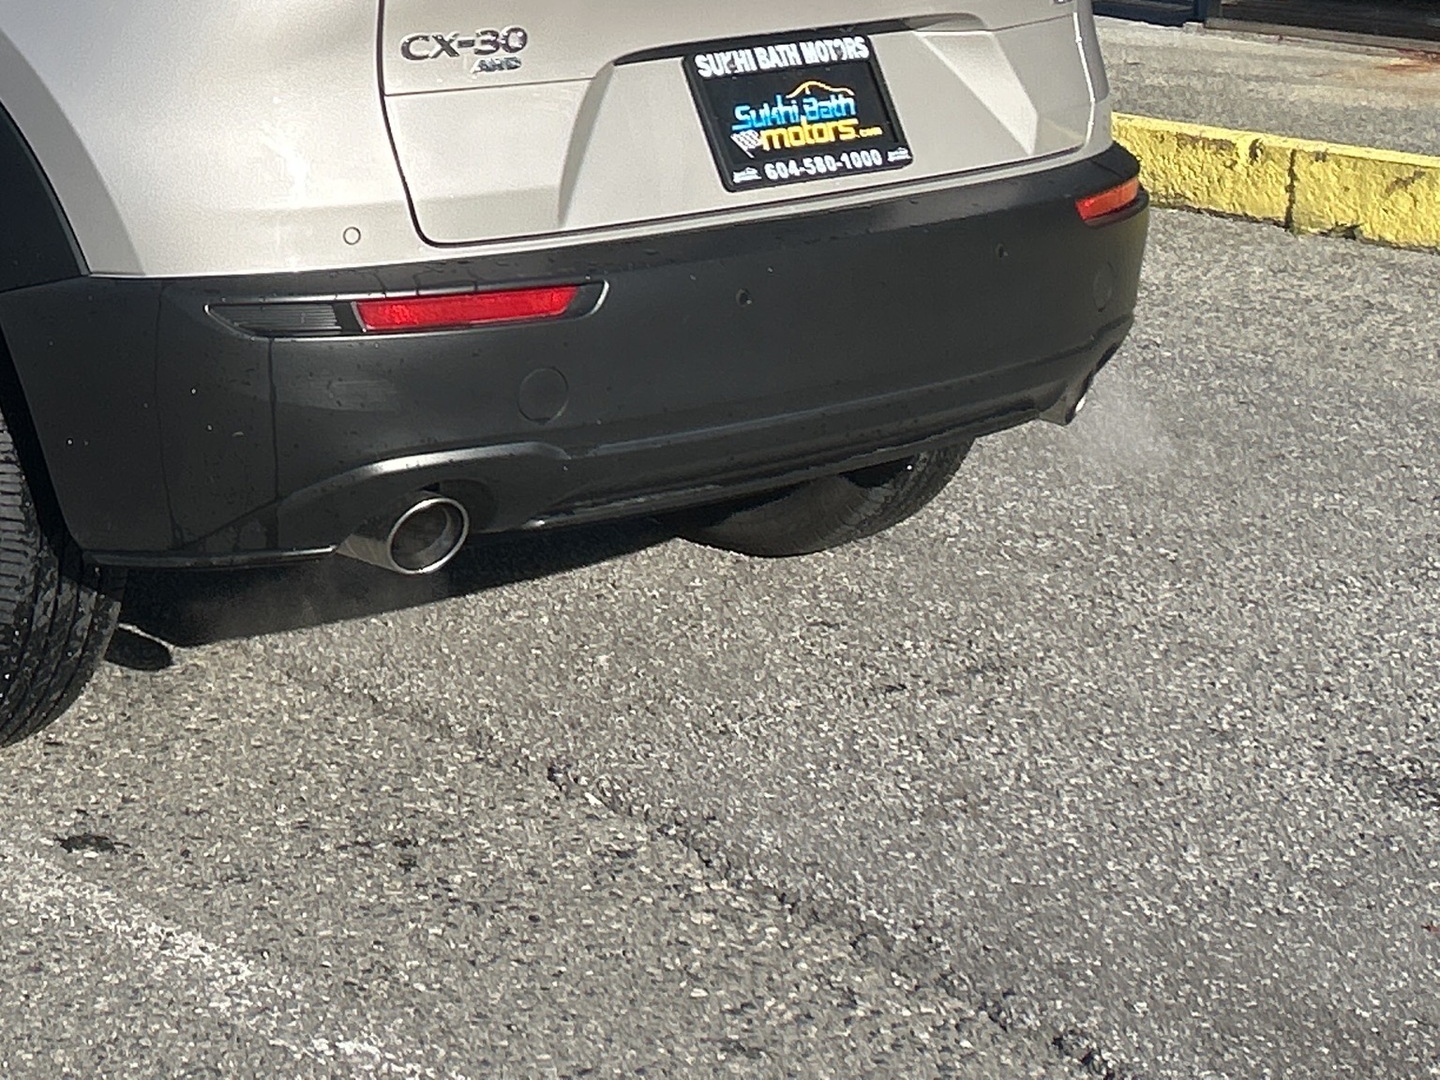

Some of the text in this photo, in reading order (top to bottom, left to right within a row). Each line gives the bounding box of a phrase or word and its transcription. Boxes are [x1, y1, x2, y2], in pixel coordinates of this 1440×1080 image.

[401, 26, 528, 61] CX-30
[694, 36, 869, 78] SUKHI BATH MOTORS
[731, 93, 857, 131] Sukhi Bath
[764, 149, 883, 180] 604-580-1000
